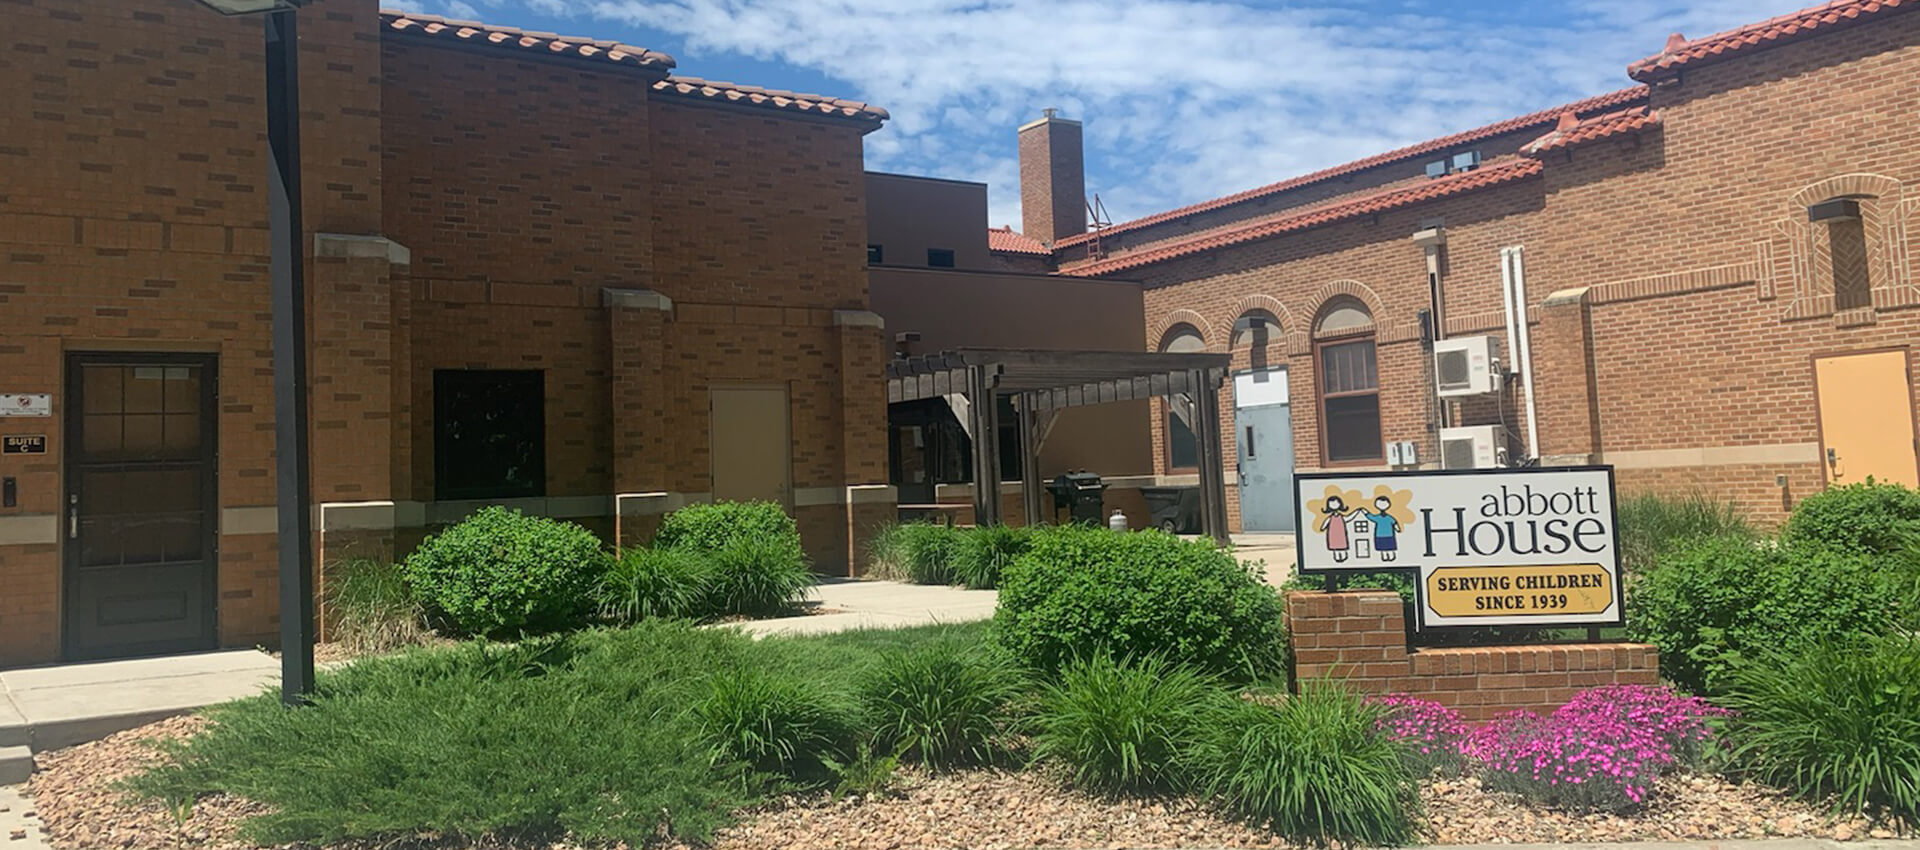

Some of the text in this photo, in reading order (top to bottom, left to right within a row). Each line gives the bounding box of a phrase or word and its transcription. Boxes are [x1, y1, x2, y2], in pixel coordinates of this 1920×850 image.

[8, 437, 41, 446] SUITE
[20, 445, 29, 453] C
[1480, 484, 1600, 518] abbott
[1419, 507, 1607, 557] House
[1438, 574, 1603, 592] SERVING CHILDREN
[1475, 594, 1568, 610] SINCE 1939
